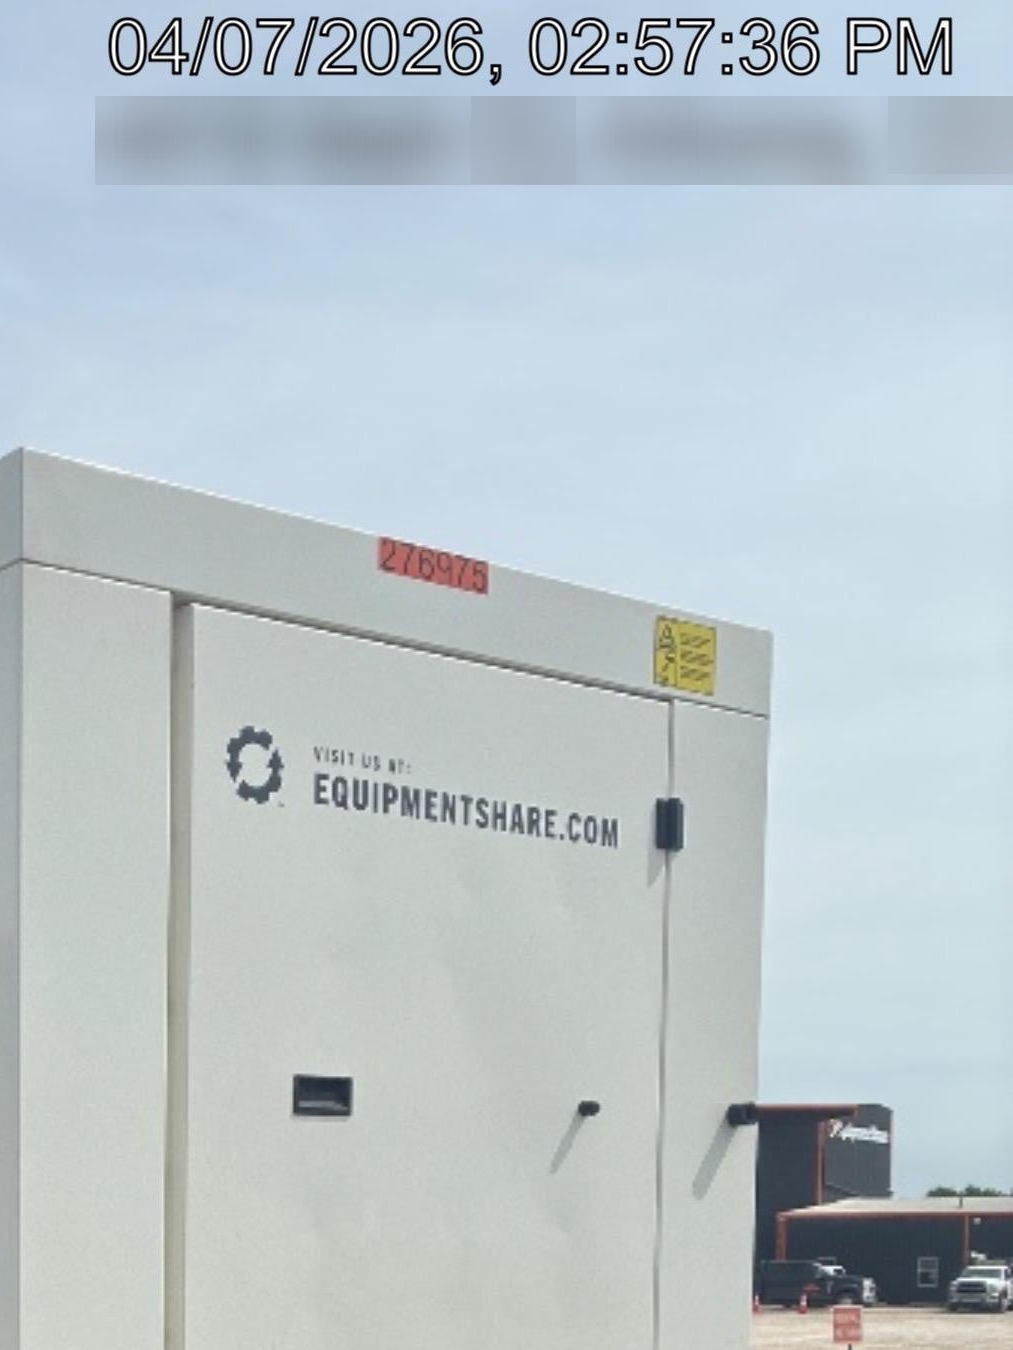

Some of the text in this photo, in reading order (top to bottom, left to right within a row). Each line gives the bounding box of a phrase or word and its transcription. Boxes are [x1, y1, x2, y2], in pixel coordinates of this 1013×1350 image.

[380, 537, 488, 594] 276975
[313, 746, 355, 766] VISIT
[361, 753, 381, 771] US
[313, 773, 620, 850] EQUIPMENTSHARE.COM
